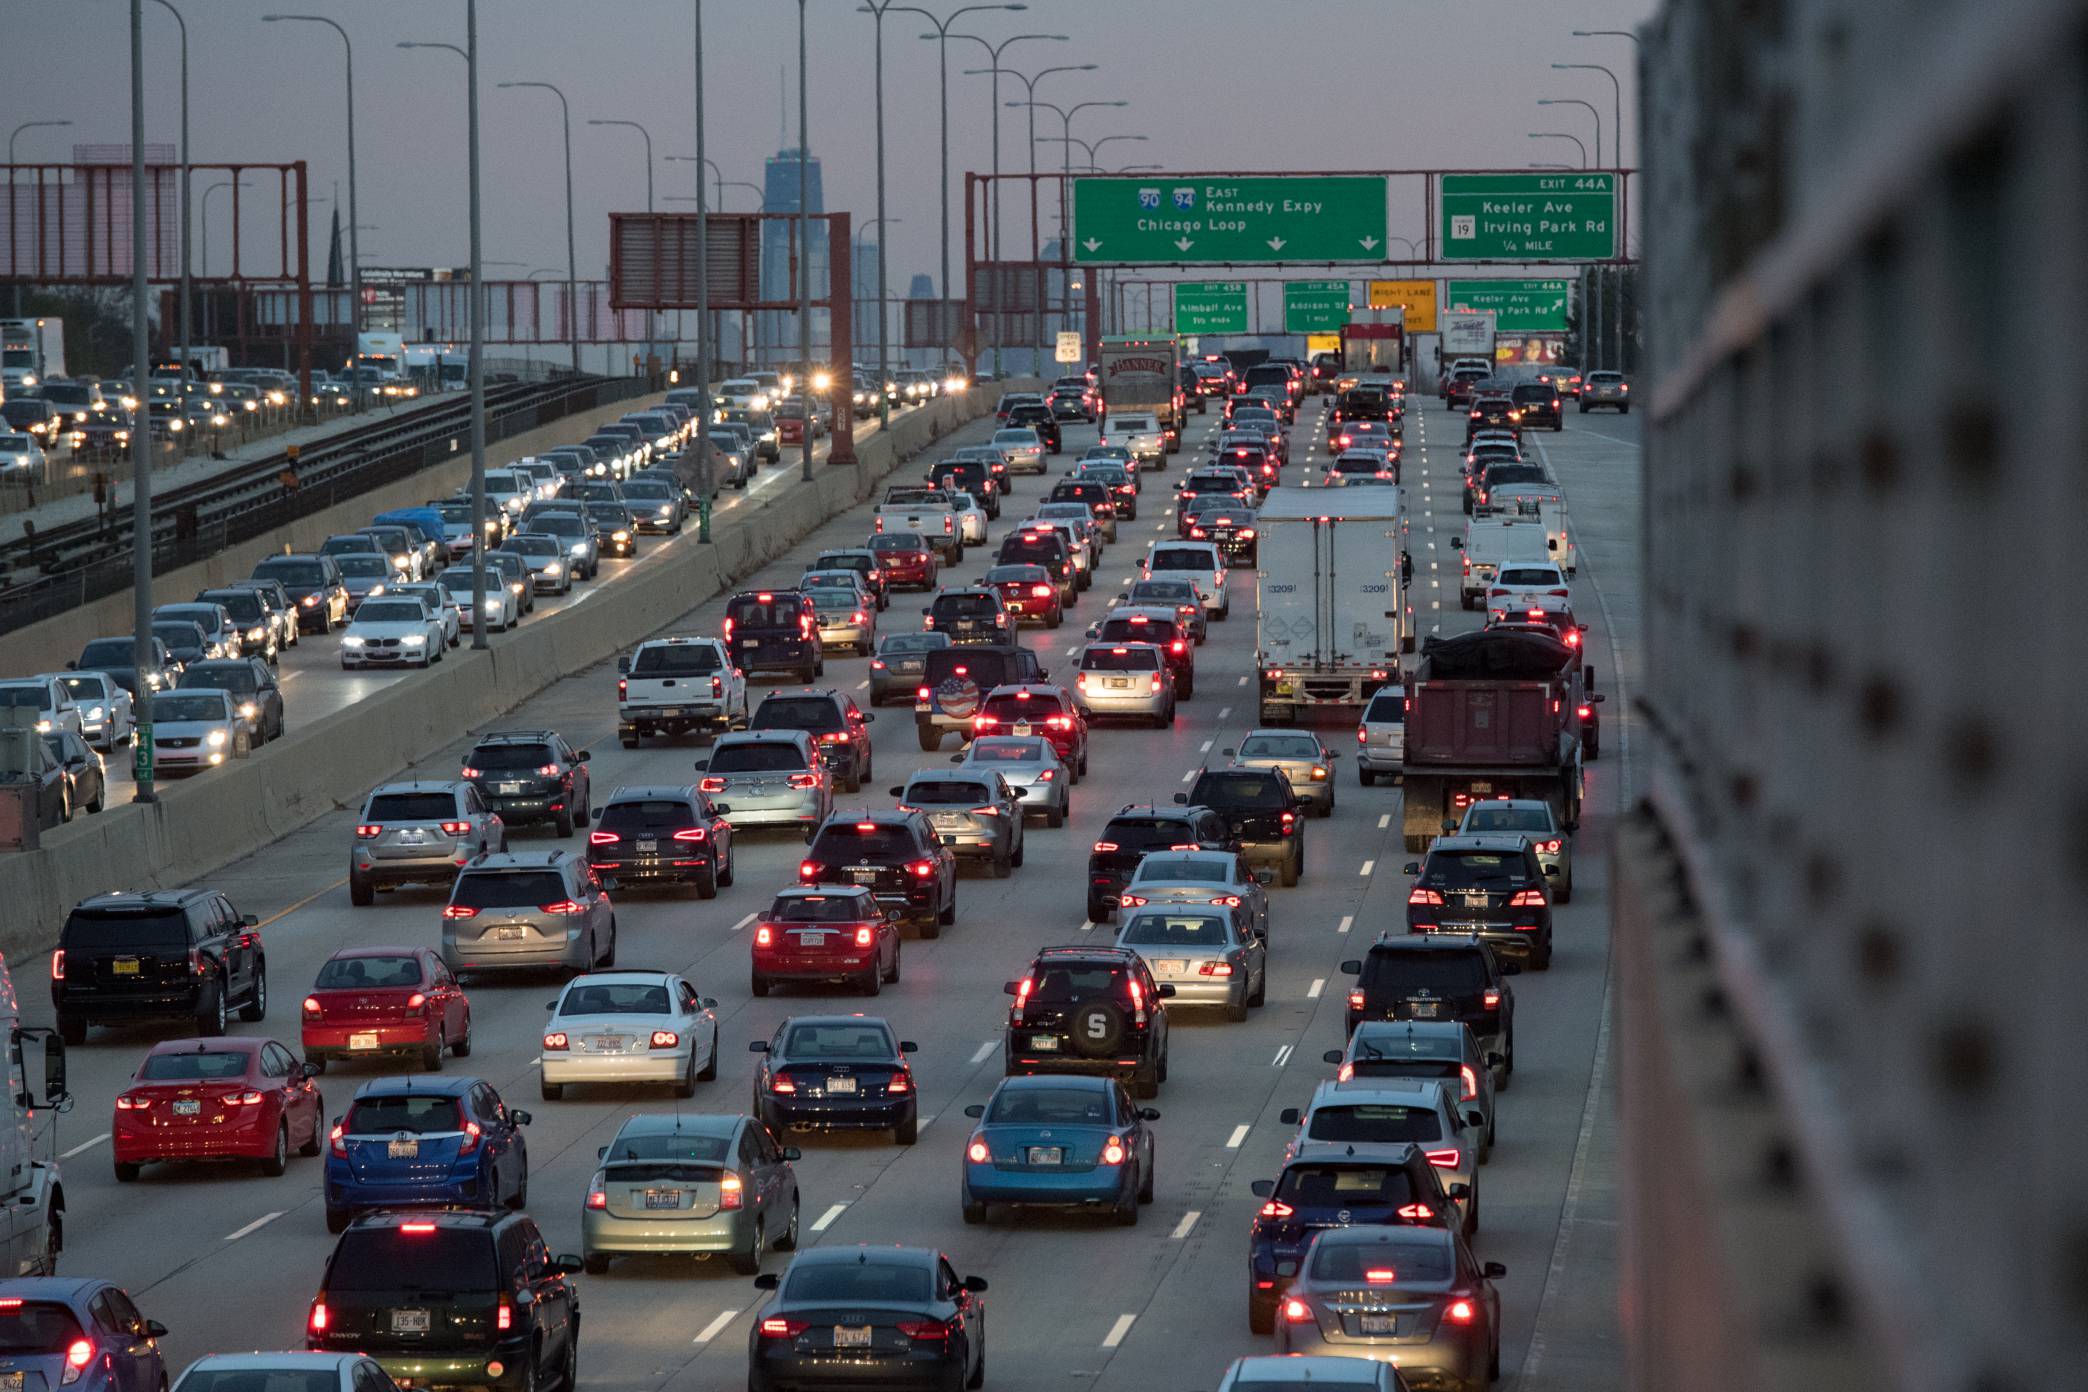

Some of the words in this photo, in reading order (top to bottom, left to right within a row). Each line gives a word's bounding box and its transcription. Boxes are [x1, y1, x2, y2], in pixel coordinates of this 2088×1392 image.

[1540, 179, 1565, 189] EXIT
[1574, 178, 1606, 189] 44A
[1206, 187, 1238, 198] EAST
[1139, 192, 1159, 207] 90
[1174, 192, 1195, 206] 94
[1206, 200, 1274, 214] Kennedy
[1283, 200, 1322, 213] Expy
[1483, 202, 1534, 213] Keeler
[1543, 201, 1573, 213] Ave
[1137, 219, 1201, 233] Chicago
[1209, 219, 1247, 232] Loop
[1457, 224, 1469, 235] 19
[1484, 221, 1532, 235] Irving
[1540, 221, 1577, 232] Park
[1586, 221, 1605, 232] Rd
[1525, 241, 1552, 250] MILE
[1374, 289, 1402, 297] RIGHT
[1224, 304, 1242, 312] Ave
[1508, 306, 1530, 314] Park
[1536, 306, 1548, 314] Rd
[1061, 348, 1076, 358] 55
[1117, 359, 1162, 373] BANNER
[1088, 1014, 1107, 1039] S
